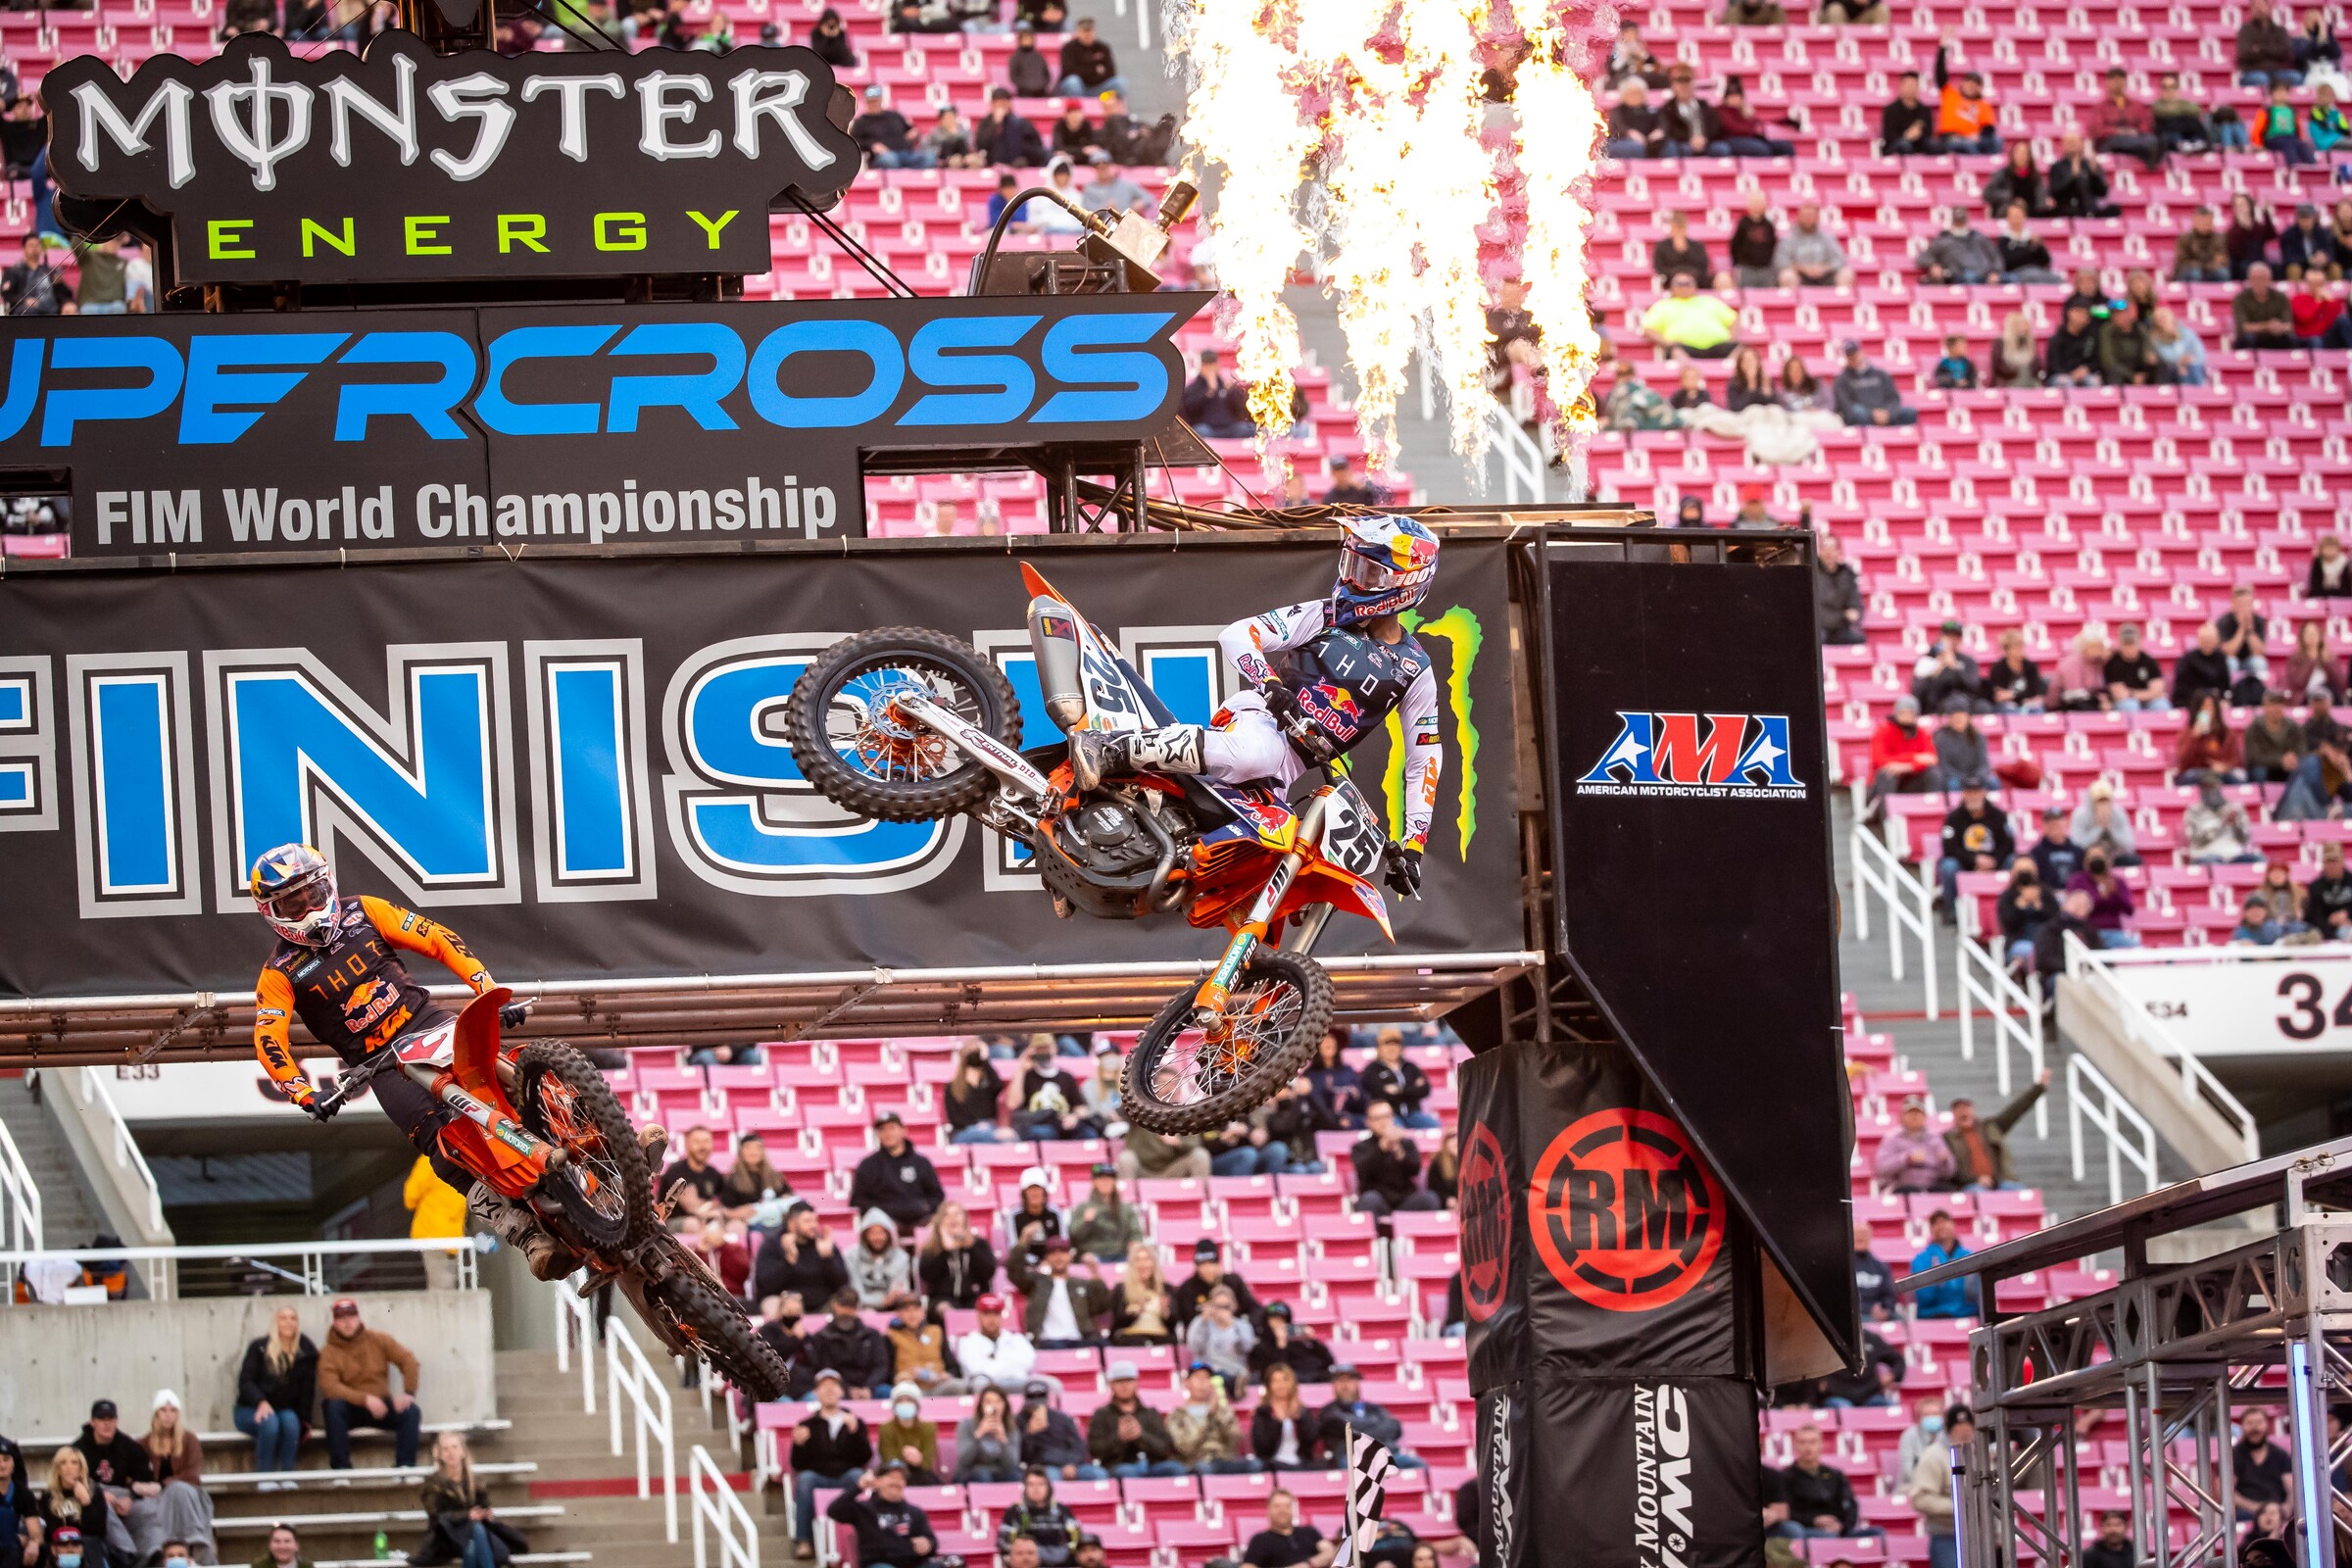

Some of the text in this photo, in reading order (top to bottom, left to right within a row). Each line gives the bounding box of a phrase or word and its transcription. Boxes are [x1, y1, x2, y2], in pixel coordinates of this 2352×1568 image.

[71, 54, 837, 191] MONSTER
[208, 210, 740, 260] ENERGY
[96, 475, 837, 545] FIM World Championship
[1083, 652, 1137, 714] 25
[0, 624, 1240, 918] INIS
[1576, 711, 1805, 787] AMA
[1577, 785, 1806, 799] AMERICAN MOTORCYCLIST ASSOCIATION
[1329, 808, 1379, 875] 25
[1218, 944, 1243, 985] MOTOREX
[1228, 937, 1258, 994] DUOP
[260, 1035, 288, 1070] KTM
[501, 1119, 539, 1143] DUOP
[503, 1130, 530, 1154] MOTOREX
[1569, 1168, 1688, 1250] RM
[1492, 1396, 1505, 1560] MOUNTAIN
[1634, 1384, 1660, 1553] MOUNTAIN
